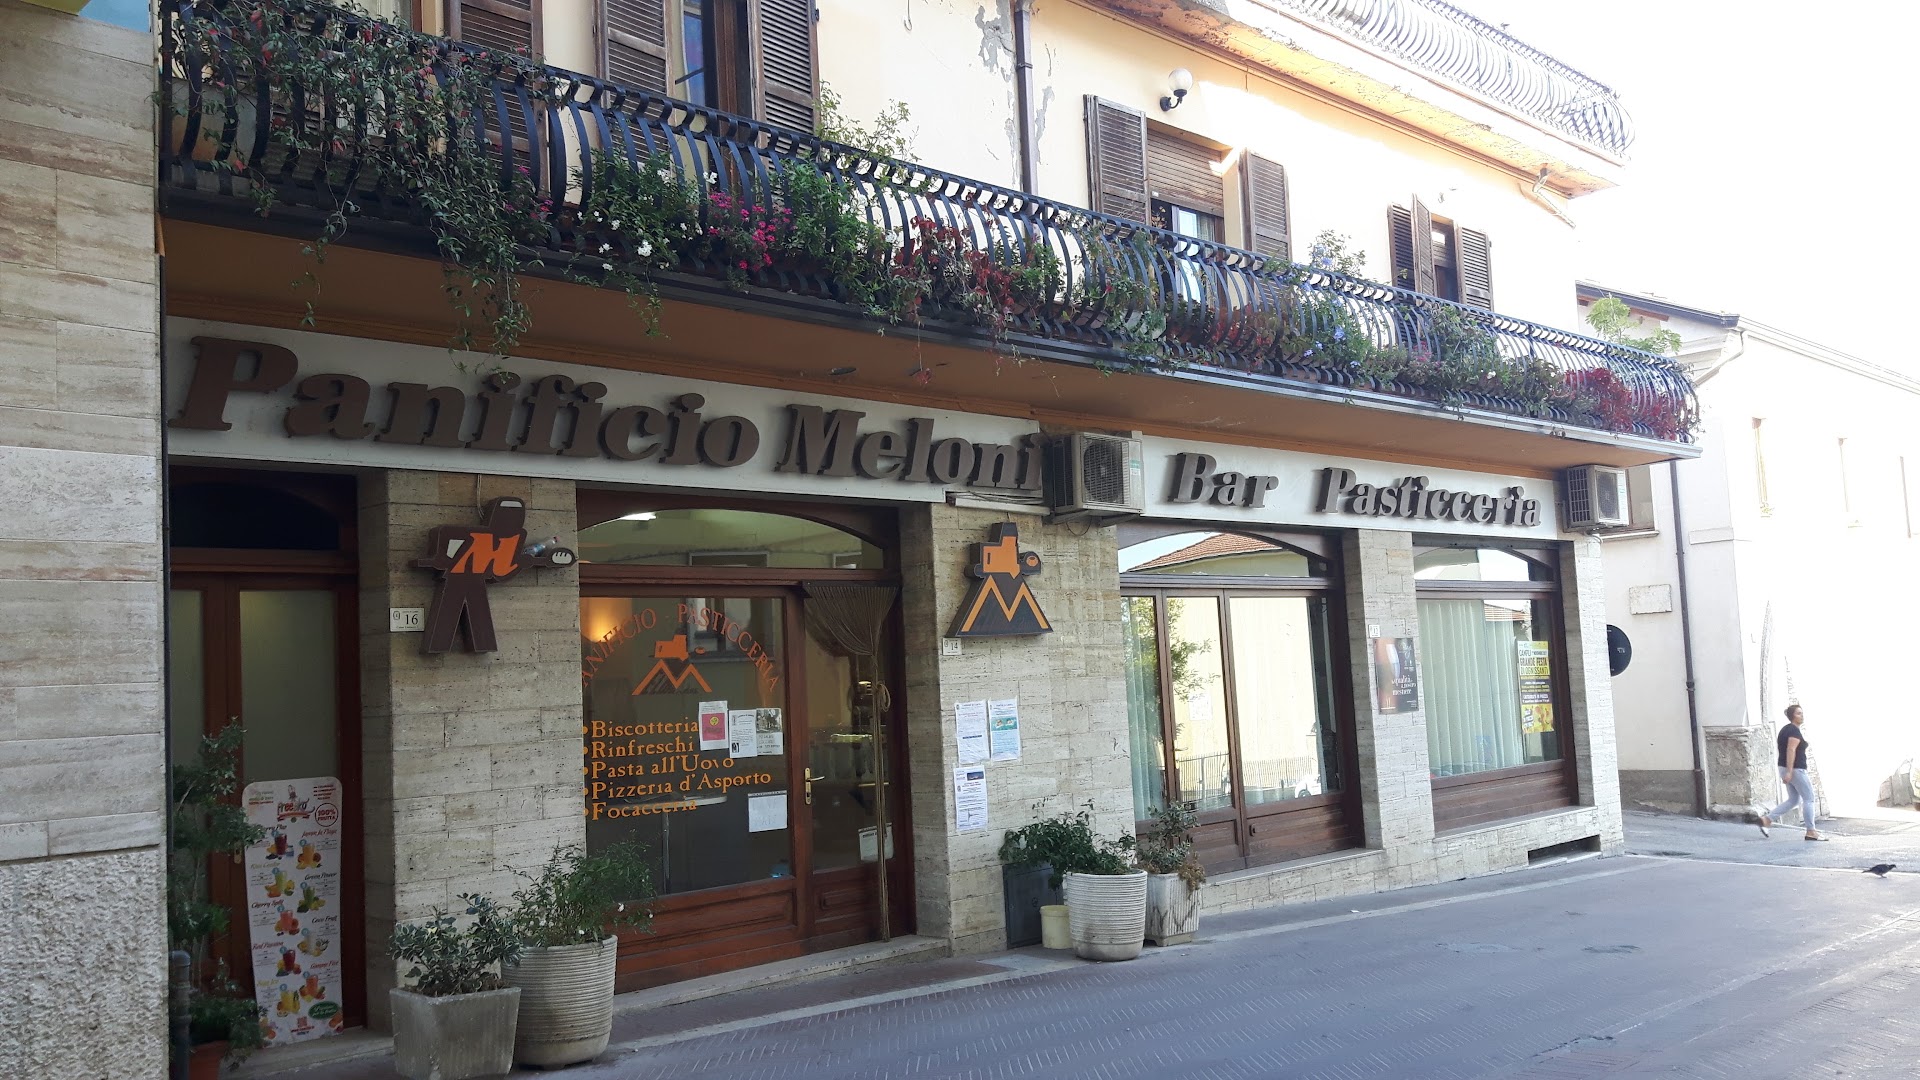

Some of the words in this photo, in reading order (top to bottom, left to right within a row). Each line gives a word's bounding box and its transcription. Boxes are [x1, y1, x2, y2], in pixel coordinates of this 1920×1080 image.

[167, 335, 760, 467] Panificio
[774, 404, 1043, 491] Meloni
[1171, 452, 1278, 509] Bar
[1317, 467, 1542, 526] Pasticceria
[405, 613, 419, 626] 16
[581, 608, 658, 688] ANIFICIO
[677, 603, 780, 692] PASTICCERIA
[950, 641, 958, 651] 14
[591, 717, 699, 738] Biscotteria
[591, 735, 695, 759] Rinfreschi
[591, 761, 644, 779] Pasta
[591, 781, 673, 800] Pizzeria
[679, 773, 771, 793] d'Asporto
[318, 809, 336, 817] 100%
[591, 796, 698, 820] Focacceria
